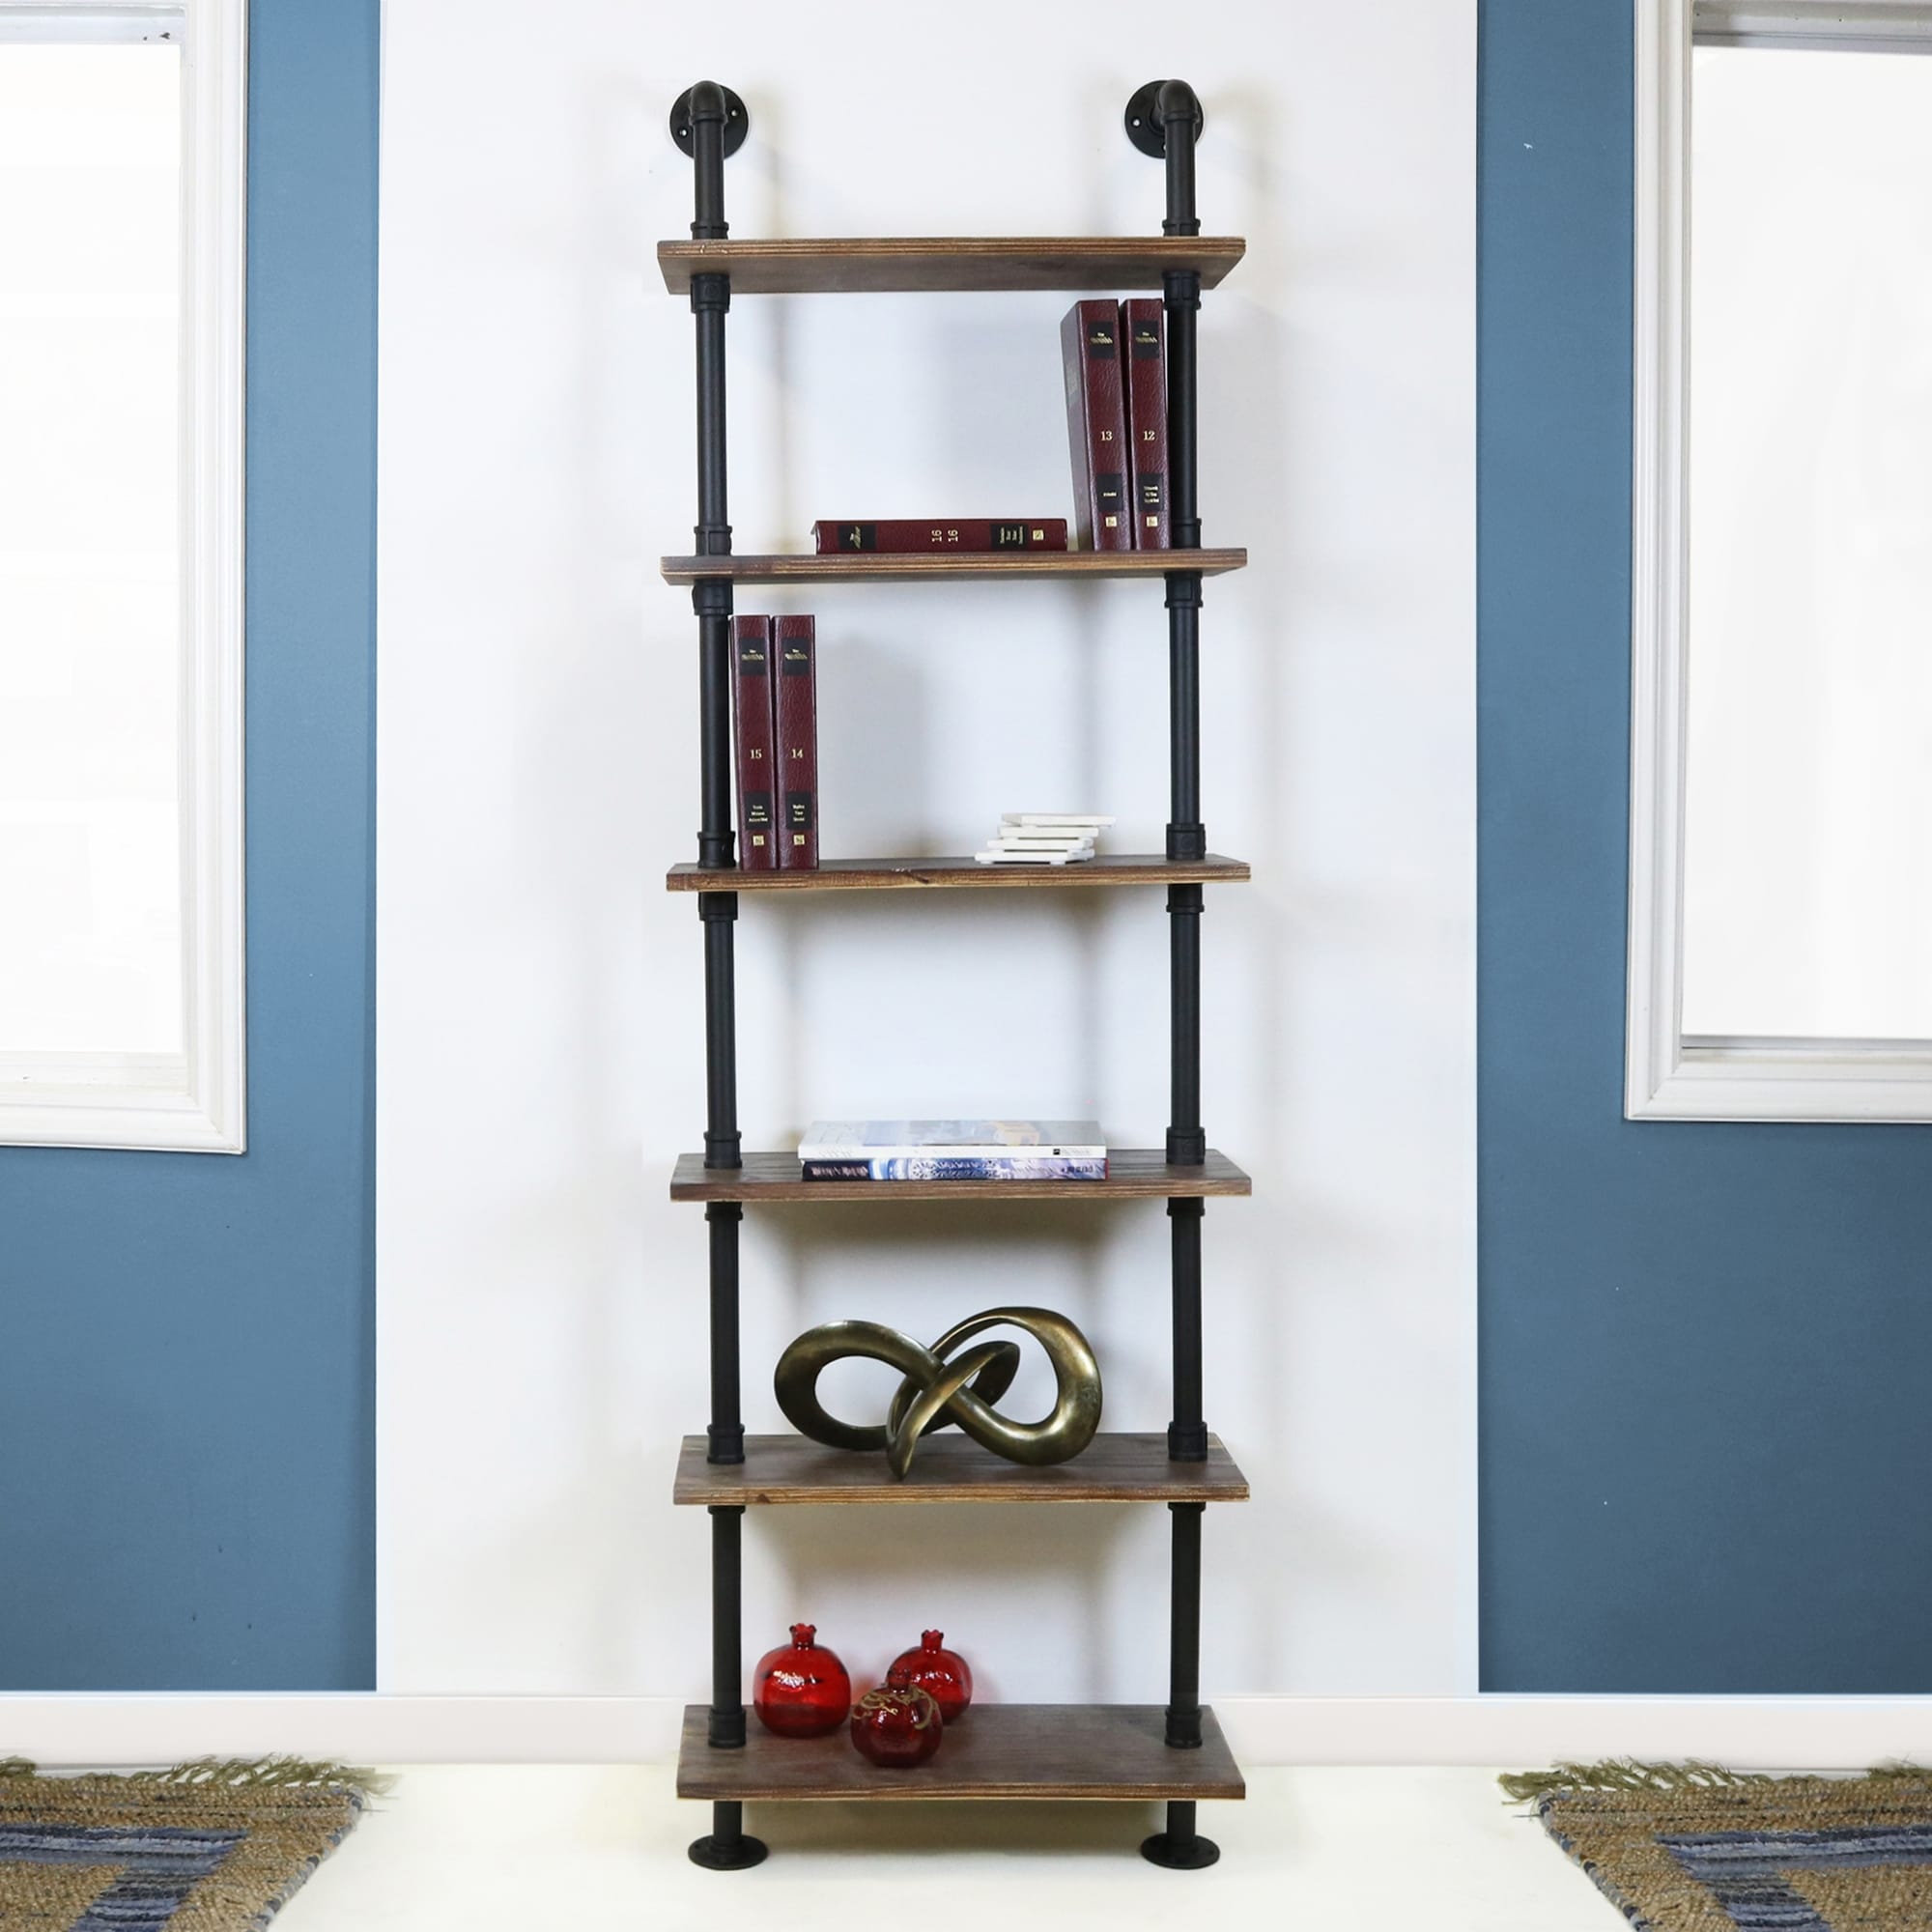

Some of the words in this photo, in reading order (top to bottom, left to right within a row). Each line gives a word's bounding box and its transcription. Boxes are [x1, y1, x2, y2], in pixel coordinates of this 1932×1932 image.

[1101, 431, 1113, 441] 13
[1144, 431, 1155, 441] 12
[931, 529, 942, 542] 16
[948, 529, 958, 542] 16
[751, 749, 762, 759] 15
[791, 749, 803, 759] 14
